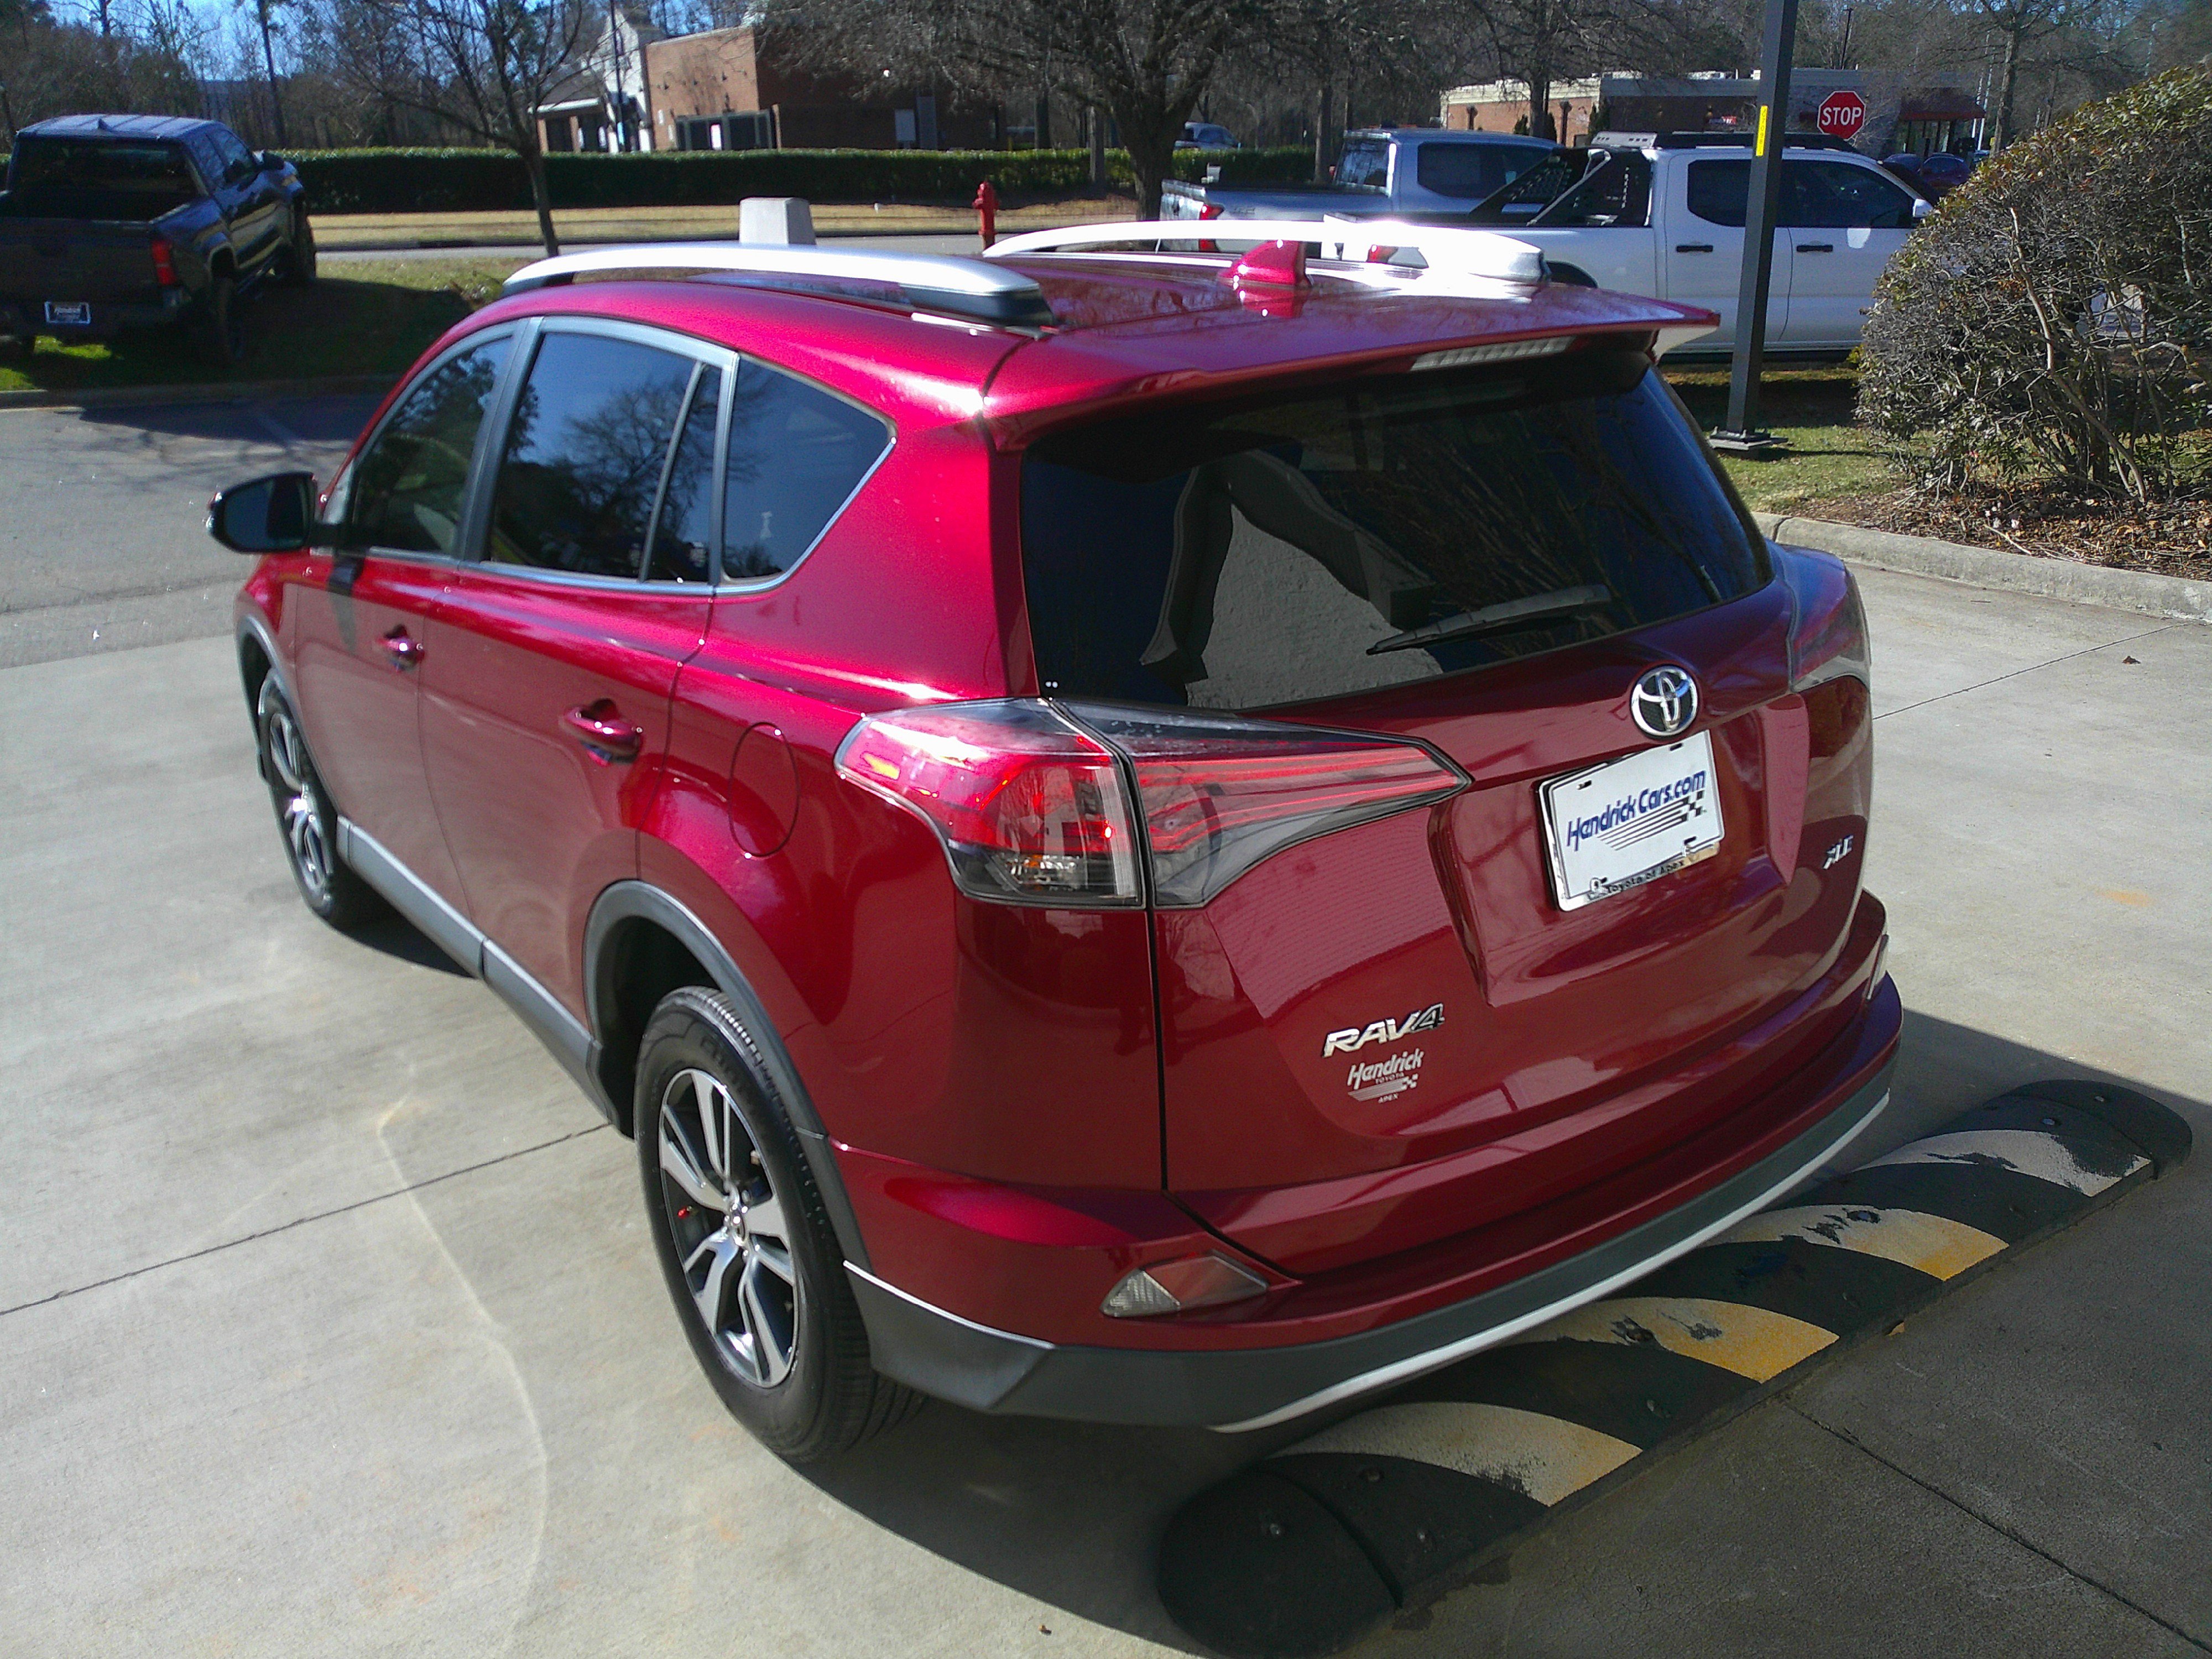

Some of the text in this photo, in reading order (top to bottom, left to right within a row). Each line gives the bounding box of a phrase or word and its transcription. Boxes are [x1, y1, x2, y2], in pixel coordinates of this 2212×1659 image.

[1822, 107, 1862, 126] STOP
[1322, 1002, 1445, 1058] RAV4
[1347, 1047, 1424, 1090] Hendrick
[1375, 1072, 1405, 1084] TOYOTA
[1378, 1093, 1399, 1104] APEX
